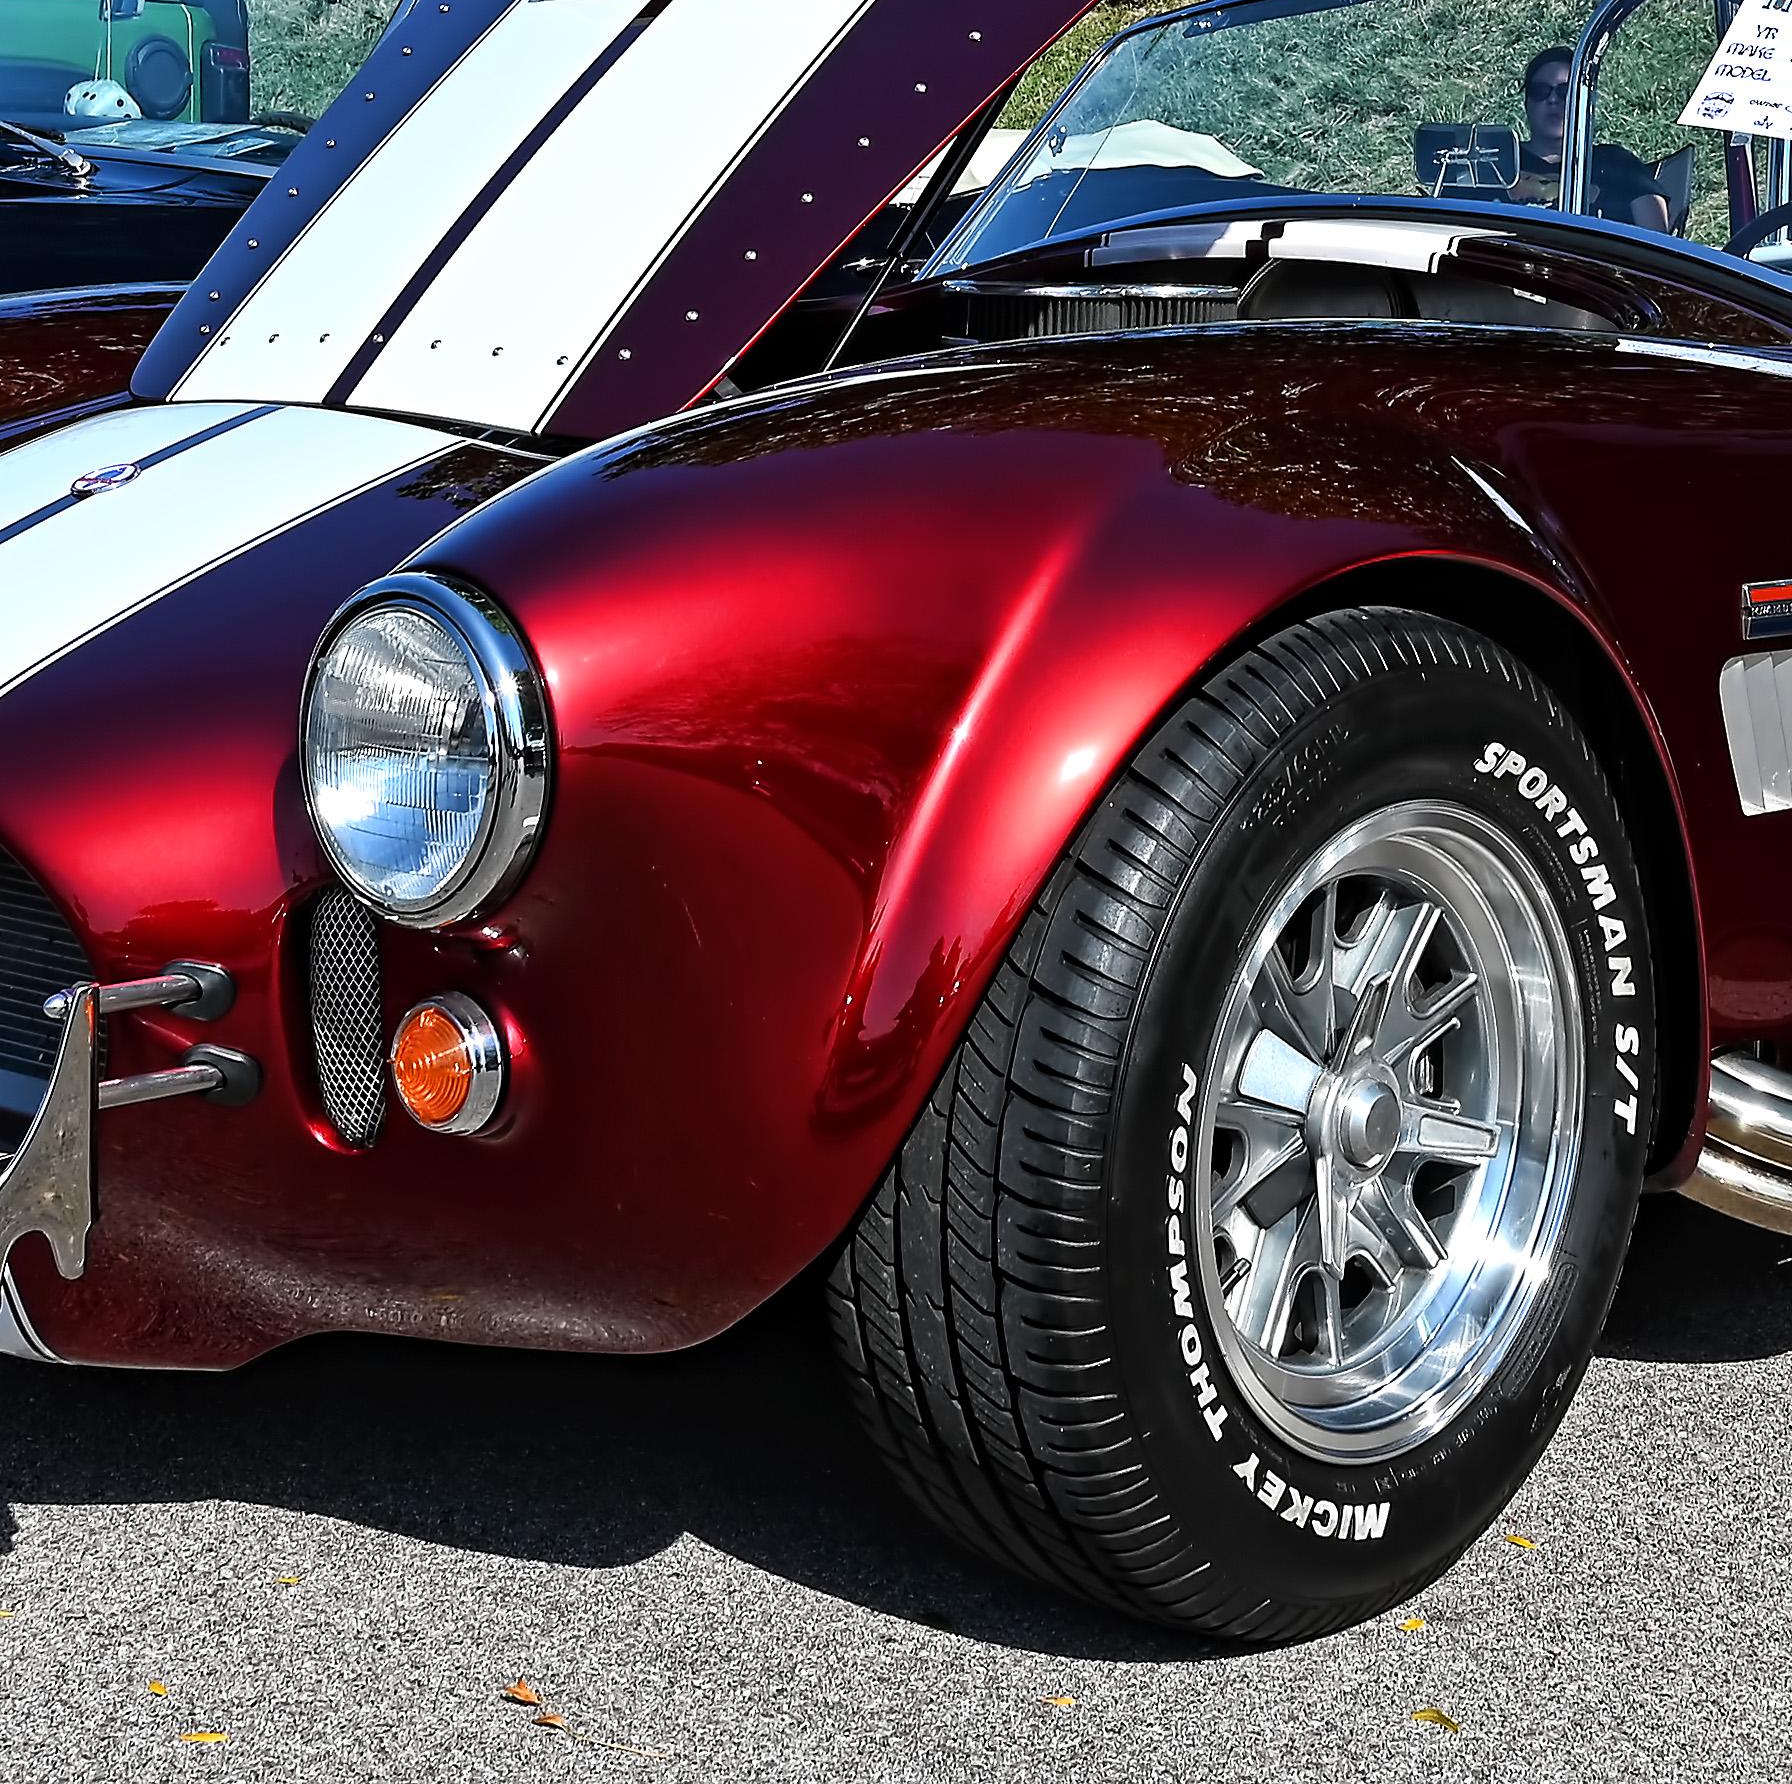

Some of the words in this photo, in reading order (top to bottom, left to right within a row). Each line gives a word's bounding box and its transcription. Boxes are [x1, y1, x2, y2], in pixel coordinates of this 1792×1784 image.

[1714, 63, 1772, 82] MODEL
[1726, 42, 1776, 60] MAKE
[1473, 741, 1637, 997] SPORTSMAN
[1613, 1023, 1640, 1135] S/T
[1168, 1062, 1229, 1442] THOMPSON
[1231, 1452, 1391, 1541] MICKEY
